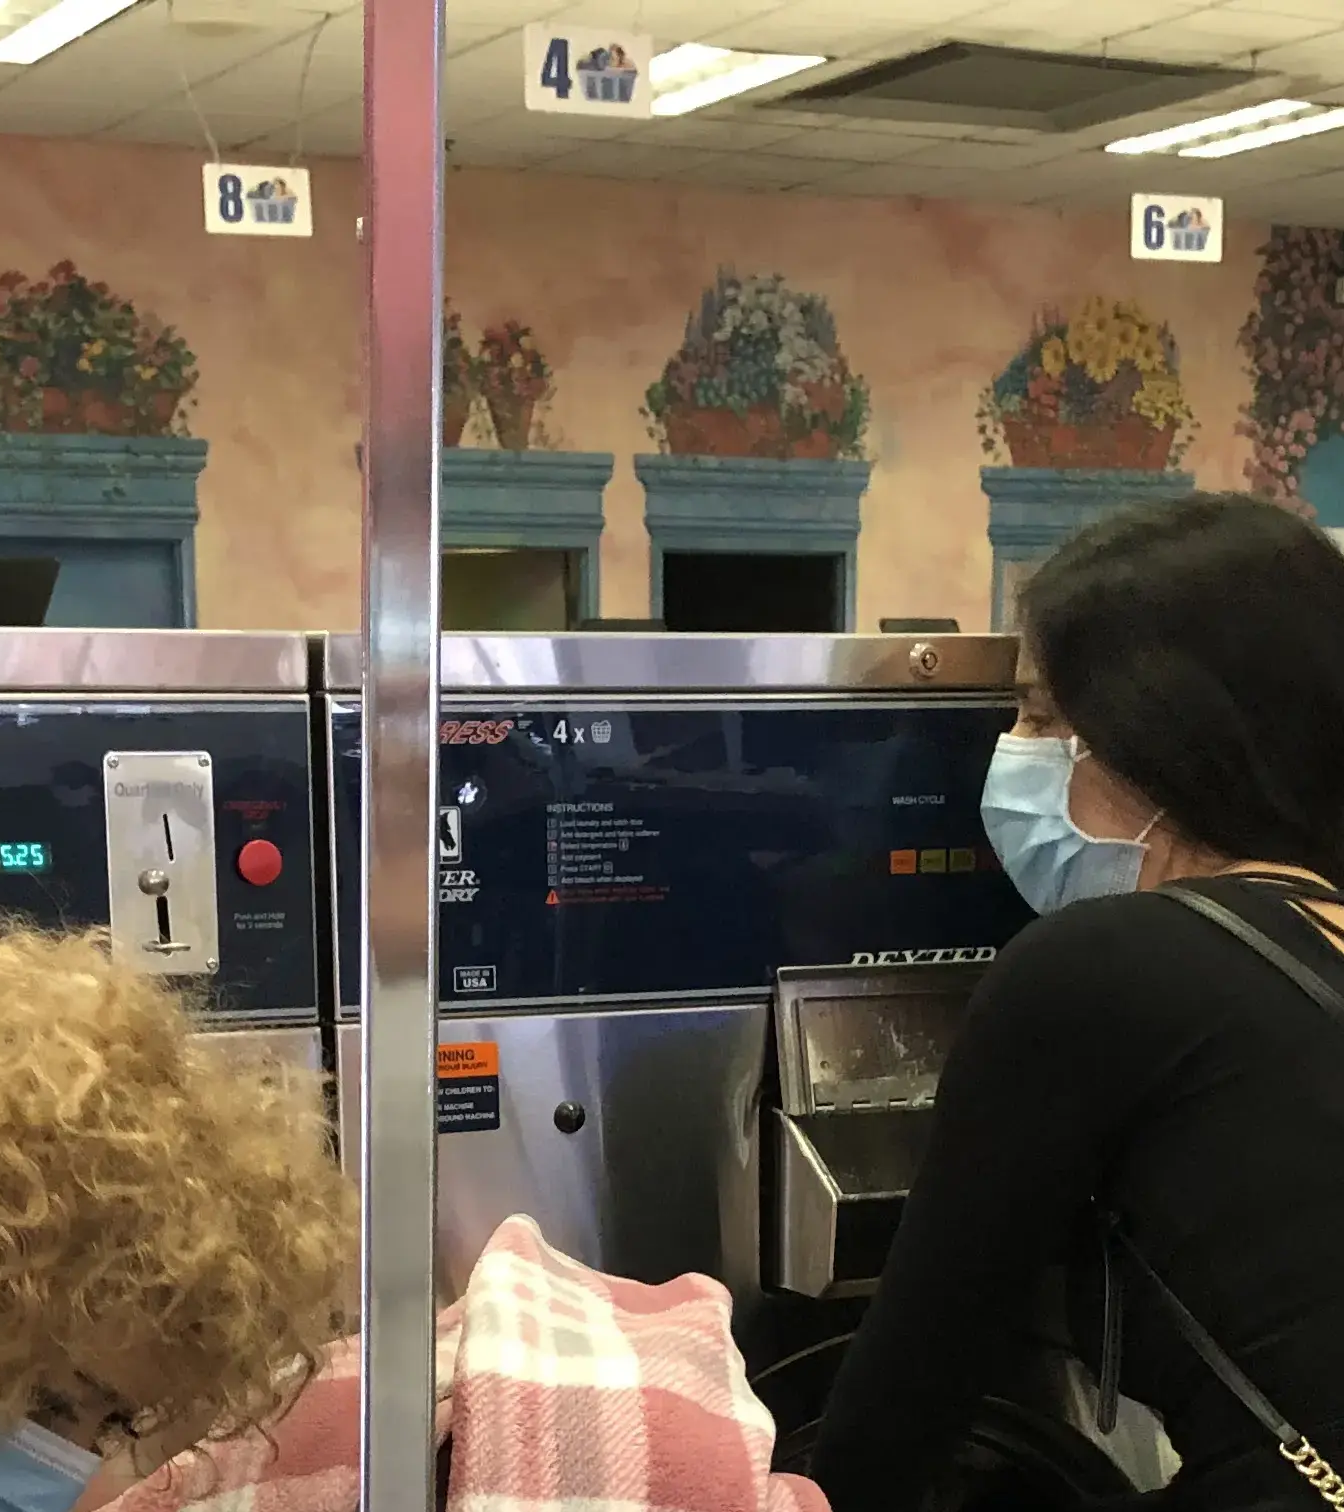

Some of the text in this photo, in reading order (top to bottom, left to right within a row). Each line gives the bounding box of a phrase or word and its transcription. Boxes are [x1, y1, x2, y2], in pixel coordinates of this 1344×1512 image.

[541, 38, 573, 99] 4
[219, 174, 243, 222] 8
[1144, 205, 1165, 250] 6
[439, 720, 514, 744] RESS
[553, 720, 567, 743] 4
[463, 978, 487, 988] USA
[439, 1049, 474, 1062] NING
